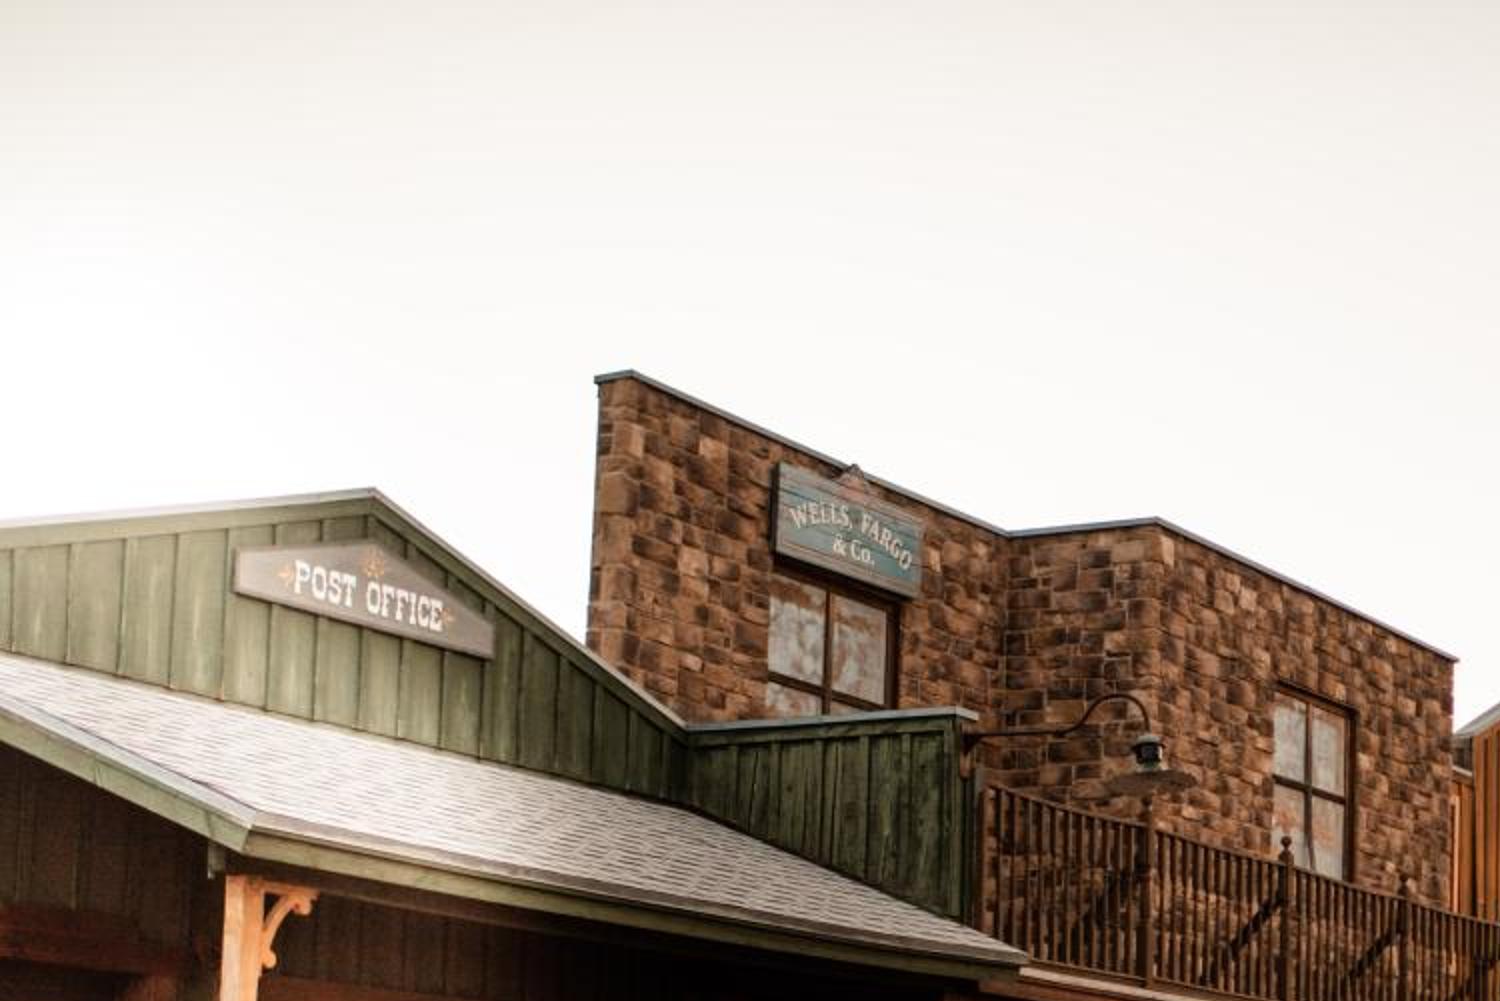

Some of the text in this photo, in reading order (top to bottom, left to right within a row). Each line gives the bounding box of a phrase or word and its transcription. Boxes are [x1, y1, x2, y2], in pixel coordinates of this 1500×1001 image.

[833, 533, 847, 557] &
[861, 512, 913, 571] FARGO
[294, 559, 444, 632] POST OFFICE
